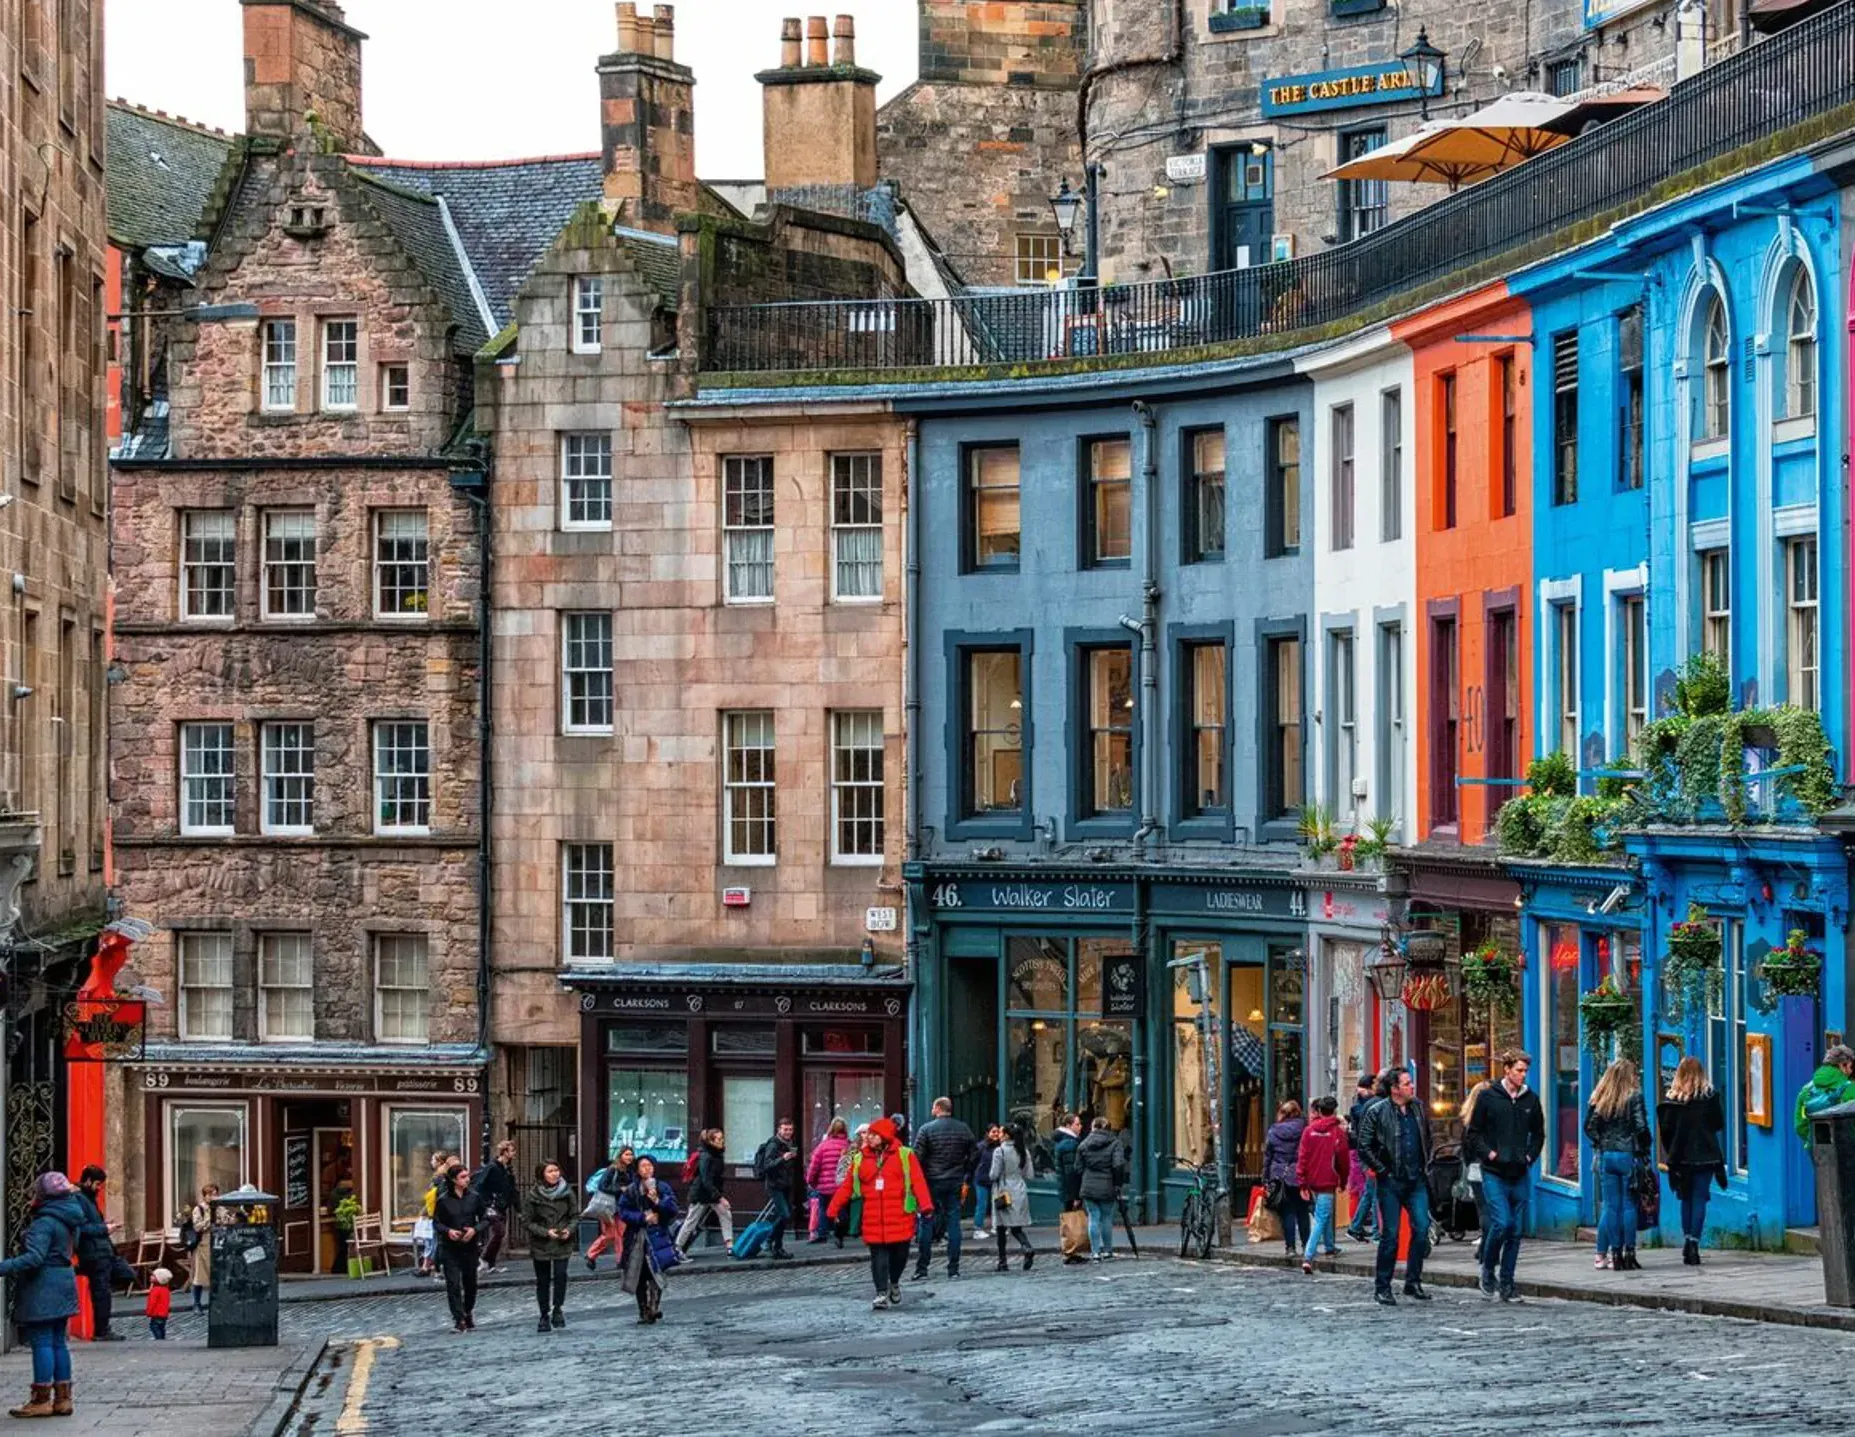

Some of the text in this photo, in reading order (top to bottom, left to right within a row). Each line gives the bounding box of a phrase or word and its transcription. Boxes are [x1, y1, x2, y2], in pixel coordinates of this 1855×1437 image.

[1269, 85, 1304, 105] THE
[1309, 75, 1375, 99] CASTLE
[932, 883, 962, 908] 46.
[992, 884, 1116, 908] Walker Slater
[1206, 891, 1262, 911] LADIESWEAR
[869, 909, 893, 919] WEST
[870, 919, 891, 929] BOW
[613, 998, 670, 1009] CLARKSONS
[809, 1001, 867, 1012] CLARKSONS
[145, 1072, 169, 1088] 89
[453, 1078, 478, 1092] 89
